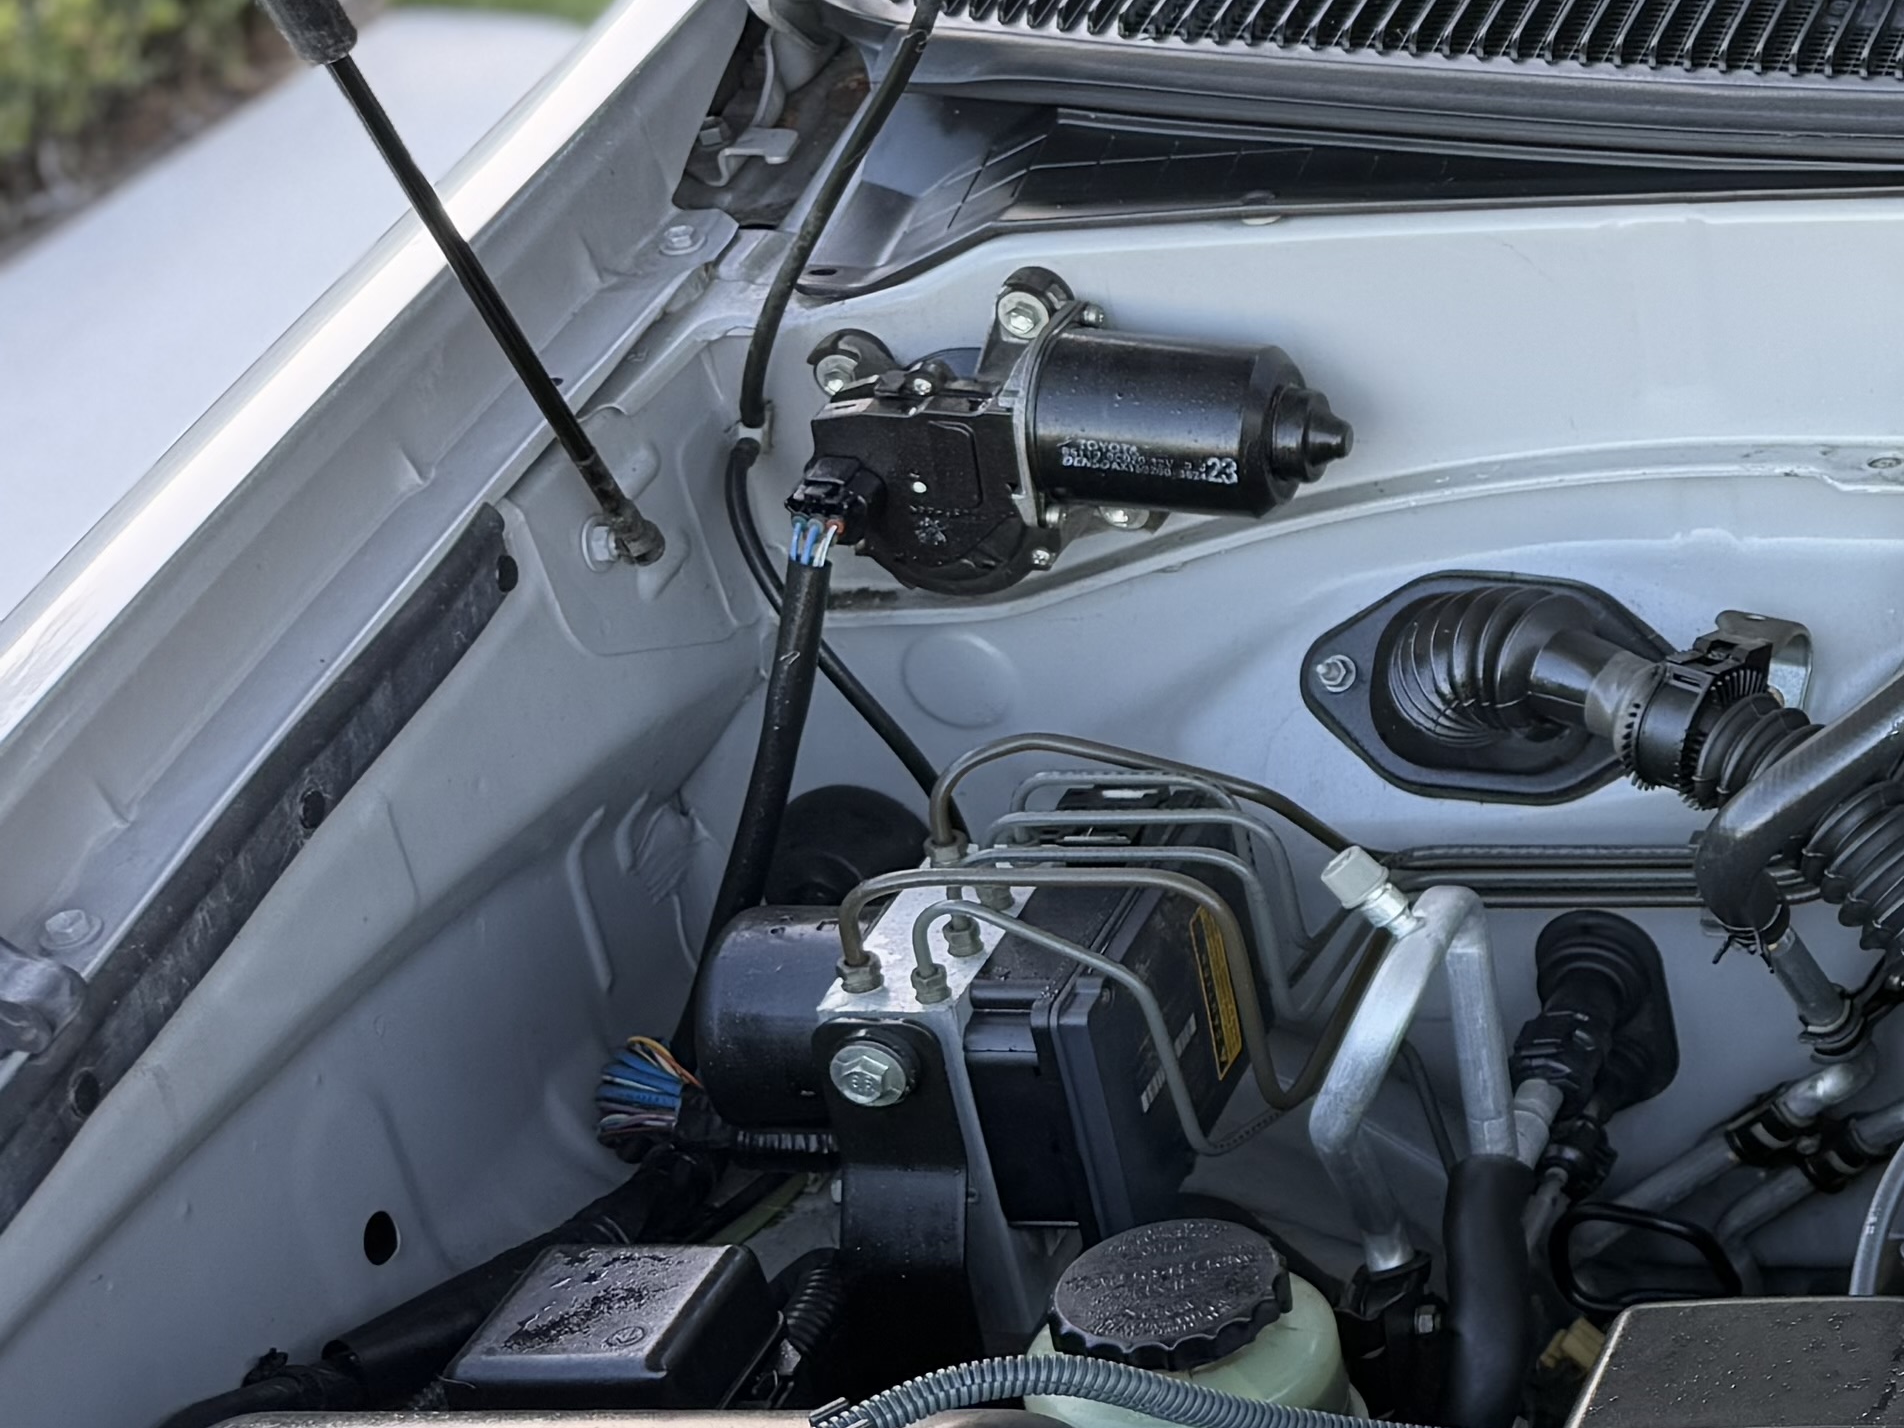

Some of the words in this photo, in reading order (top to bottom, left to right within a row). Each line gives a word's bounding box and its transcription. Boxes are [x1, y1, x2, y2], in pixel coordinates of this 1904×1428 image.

[1079, 439, 1140, 455] TOYOTA
[1062, 456, 1111, 469] DENSO
[1206, 457, 1238, 485] 23
